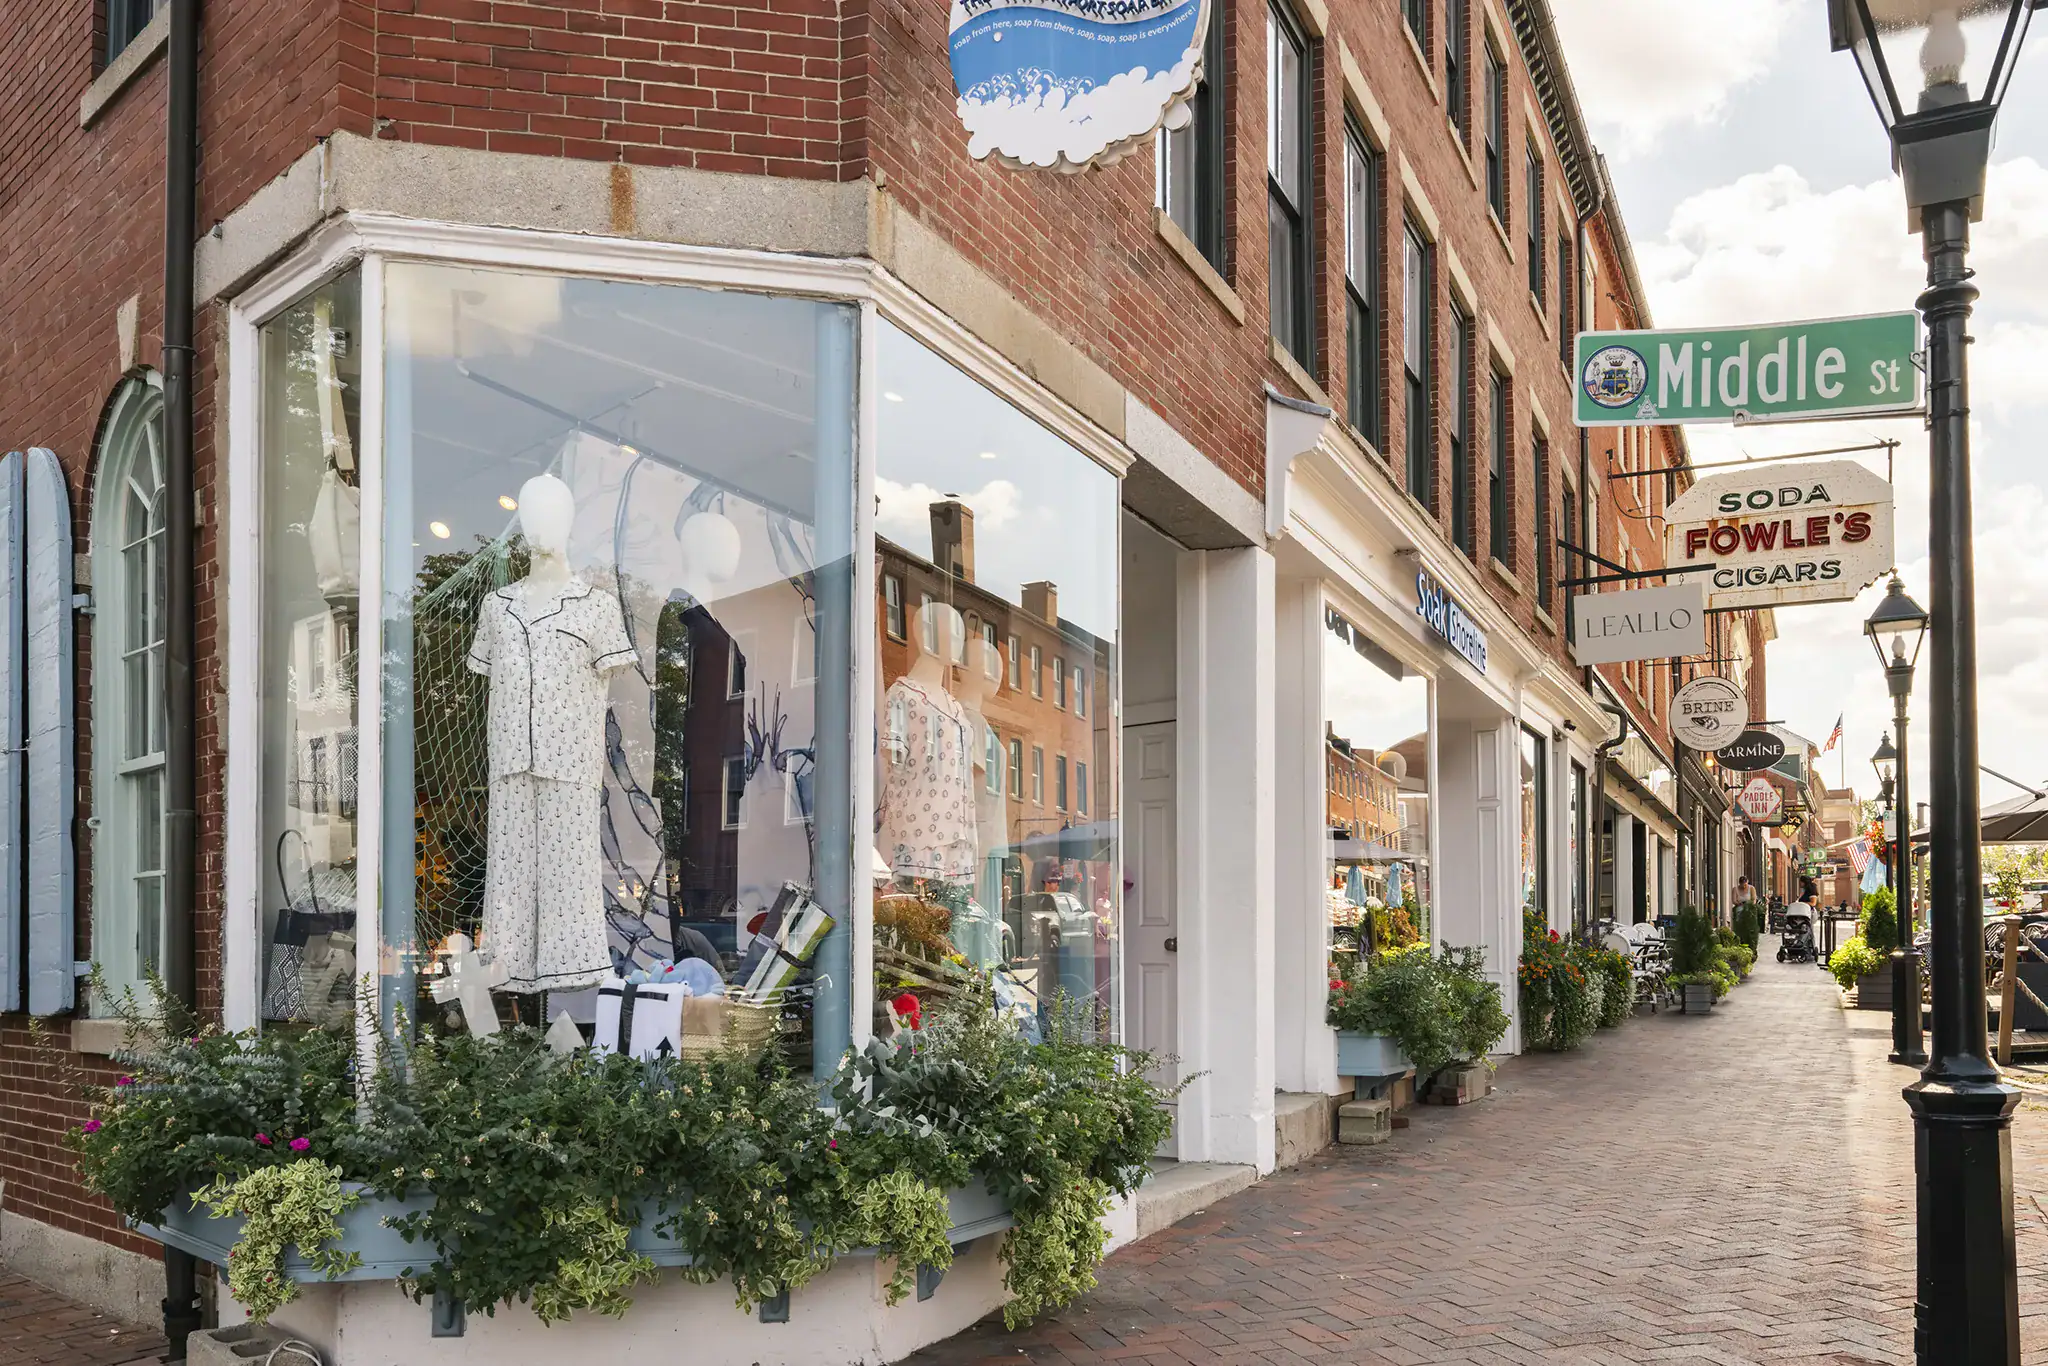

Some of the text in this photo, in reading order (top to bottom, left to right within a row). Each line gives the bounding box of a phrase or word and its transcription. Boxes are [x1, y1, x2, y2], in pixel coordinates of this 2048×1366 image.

[954, 5, 1197, 49] soap from here, soap from there, soap, soap, soap is everywhere!
[1658, 334, 1901, 409] Middle St
[1717, 483, 1831, 513] SODA
[1686, 511, 1872, 559] FOWLE'S
[1713, 559, 1842, 589] CIGARS
[1416, 572, 1487, 671] Soak Shoreline
[1585, 608, 1692, 638] LEALLO
[1682, 701, 1735, 715] BRINE
[1717, 743, 1781, 758] CARMINE
[1744, 792, 1774, 802] PADDLE
[1751, 802, 1767, 813] INN
